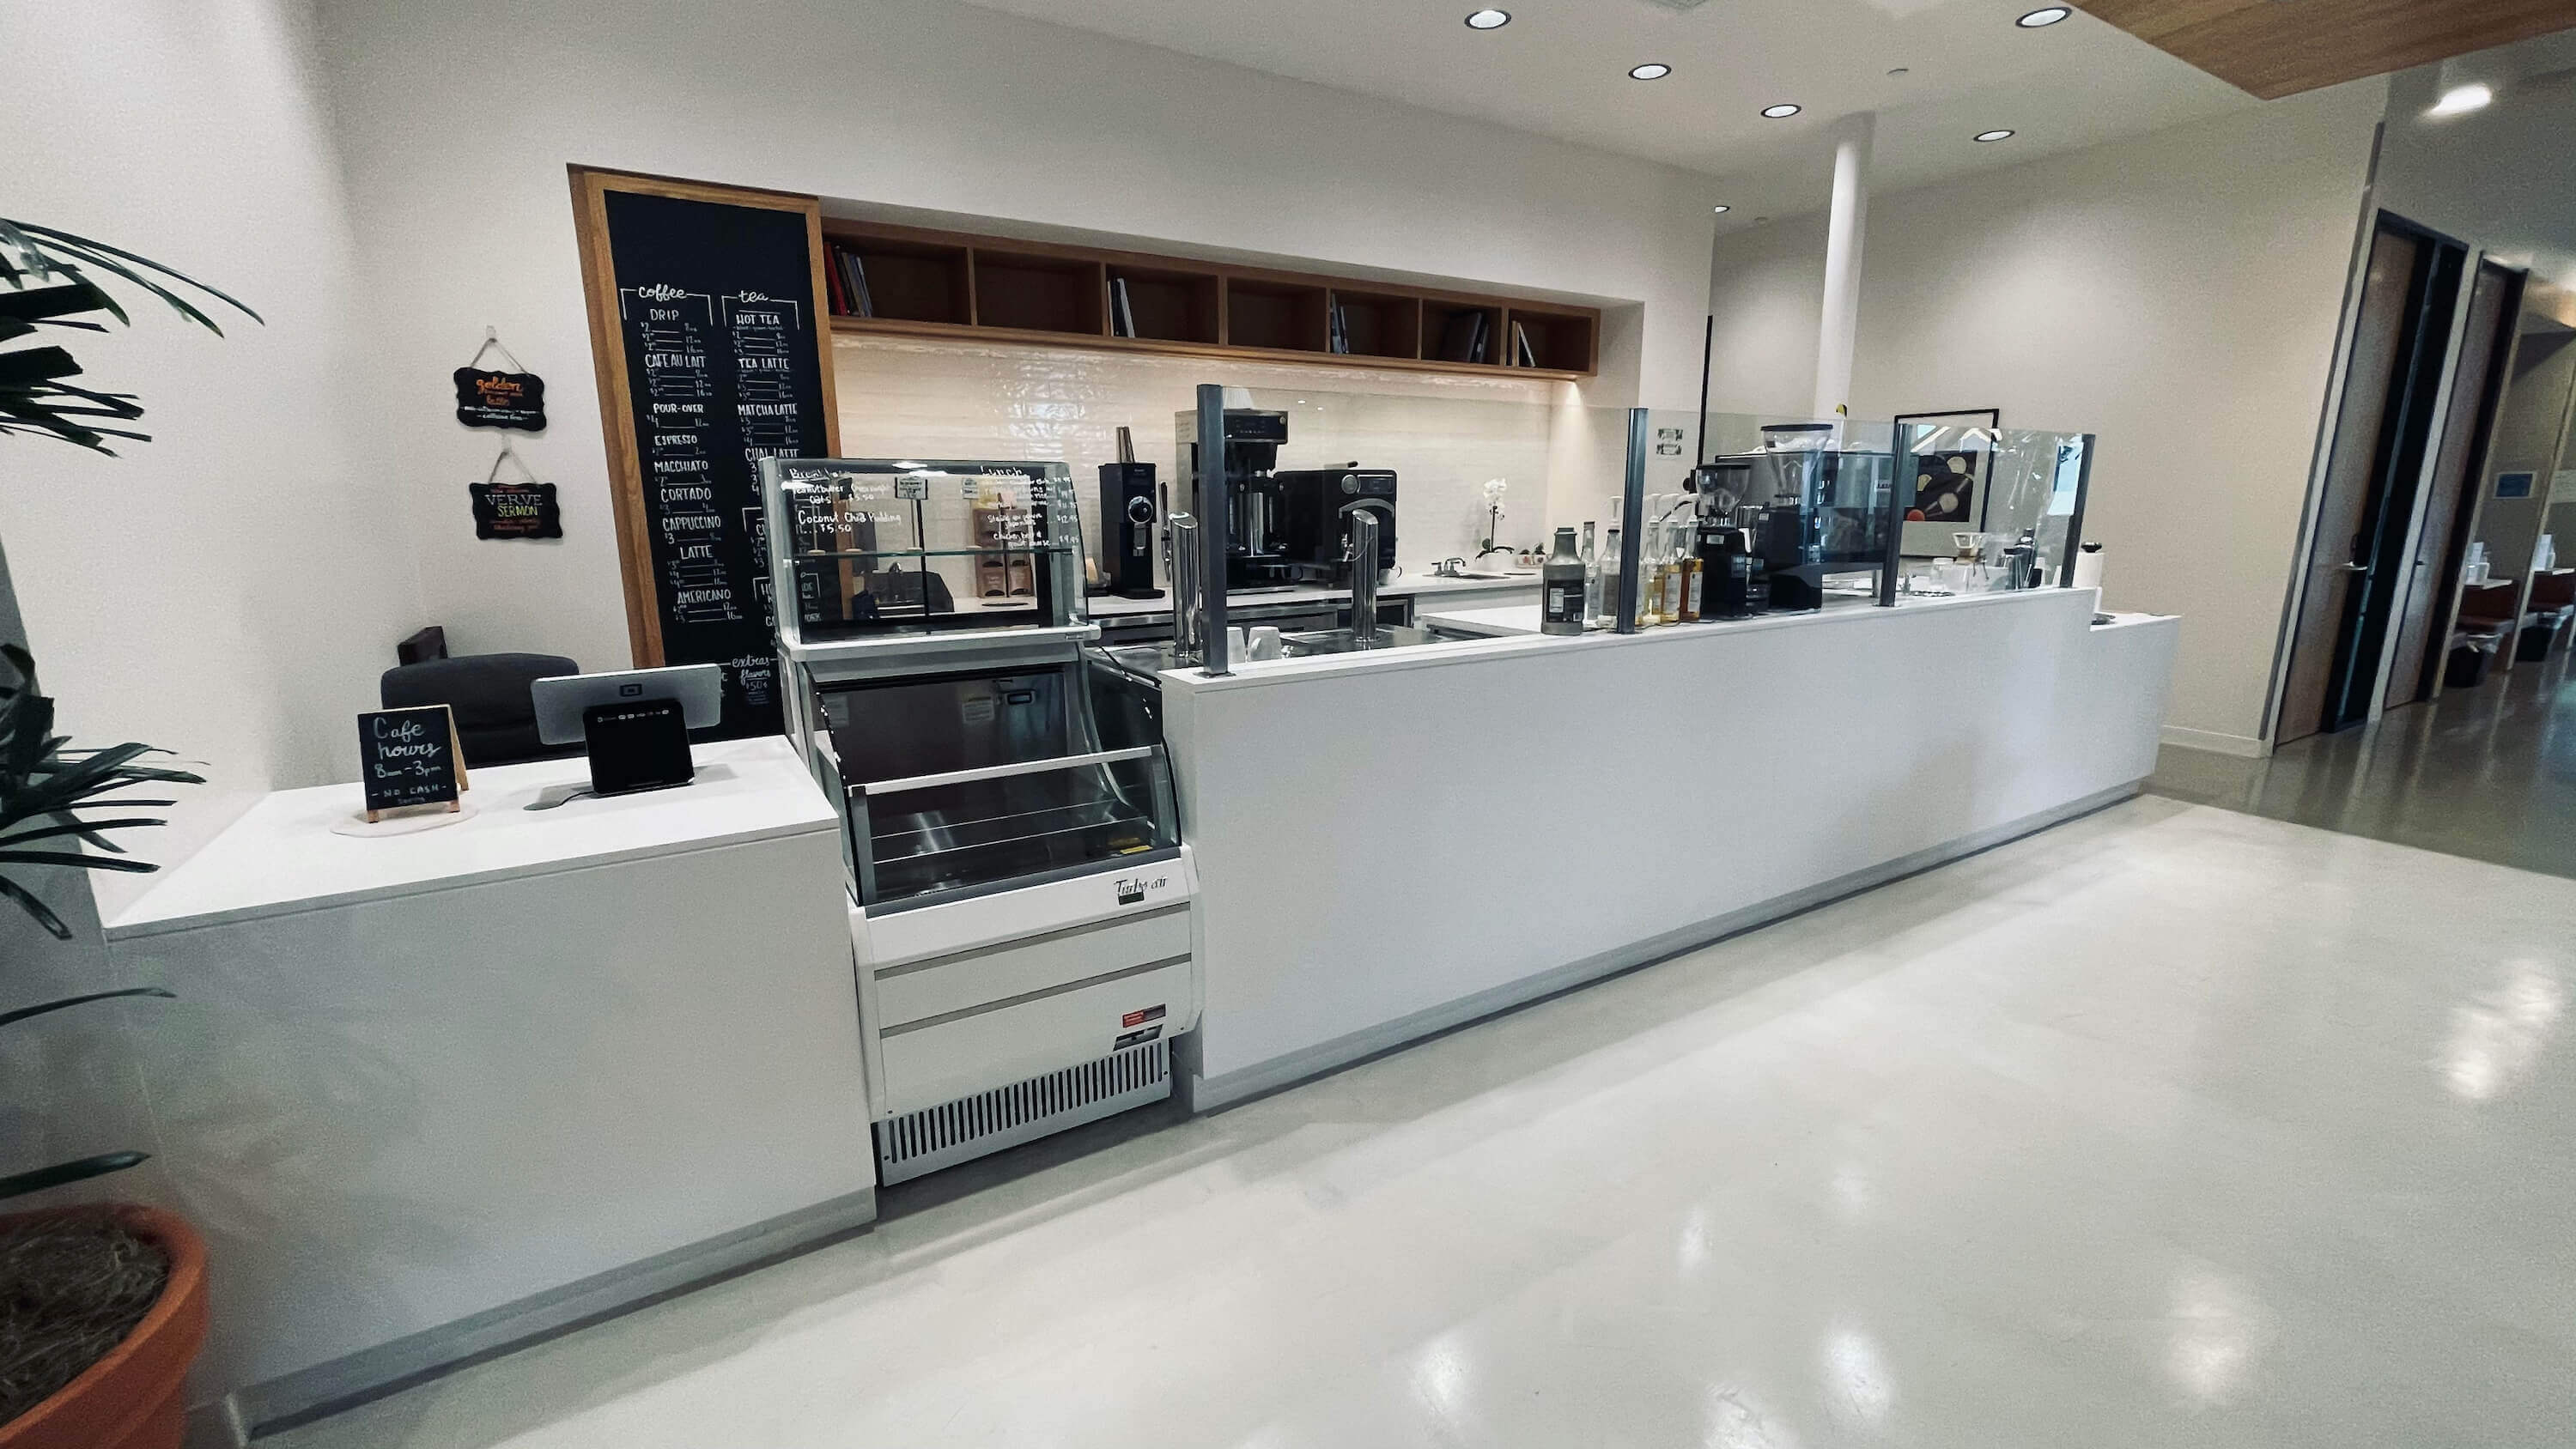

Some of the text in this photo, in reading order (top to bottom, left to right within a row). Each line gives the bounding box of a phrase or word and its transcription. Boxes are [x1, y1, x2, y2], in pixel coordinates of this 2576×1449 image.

[638, 283, 688, 302] coffee
[738, 290, 769, 303] tea
[650, 308, 679, 321] DRIP
[736, 314, 780, 325] HOT TEA
[671, 354, 683, 367] AU
[738, 358, 790, 369] TEA LATTE
[653, 403, 704, 414] POUR-OVER
[738, 404, 775, 417] MATCHA
[654, 434, 698, 446] ESPRESSO
[653, 460, 709, 474] MACCHIATO
[484, 494, 544, 506] VERVE
[660, 487, 713, 503] CORTADO
[496, 505, 539, 518] SERMON
[798, 510, 839, 524] Coconut
[844, 512, 866, 523] Chia
[662, 516, 721, 532] CAPPUCCINO
[679, 544, 714, 561] LATTE
[677, 589, 732, 604] AMERICANO
[732, 654, 770, 668] extras
[373, 717, 426, 743] Cafe
[378, 741, 442, 761] hours
